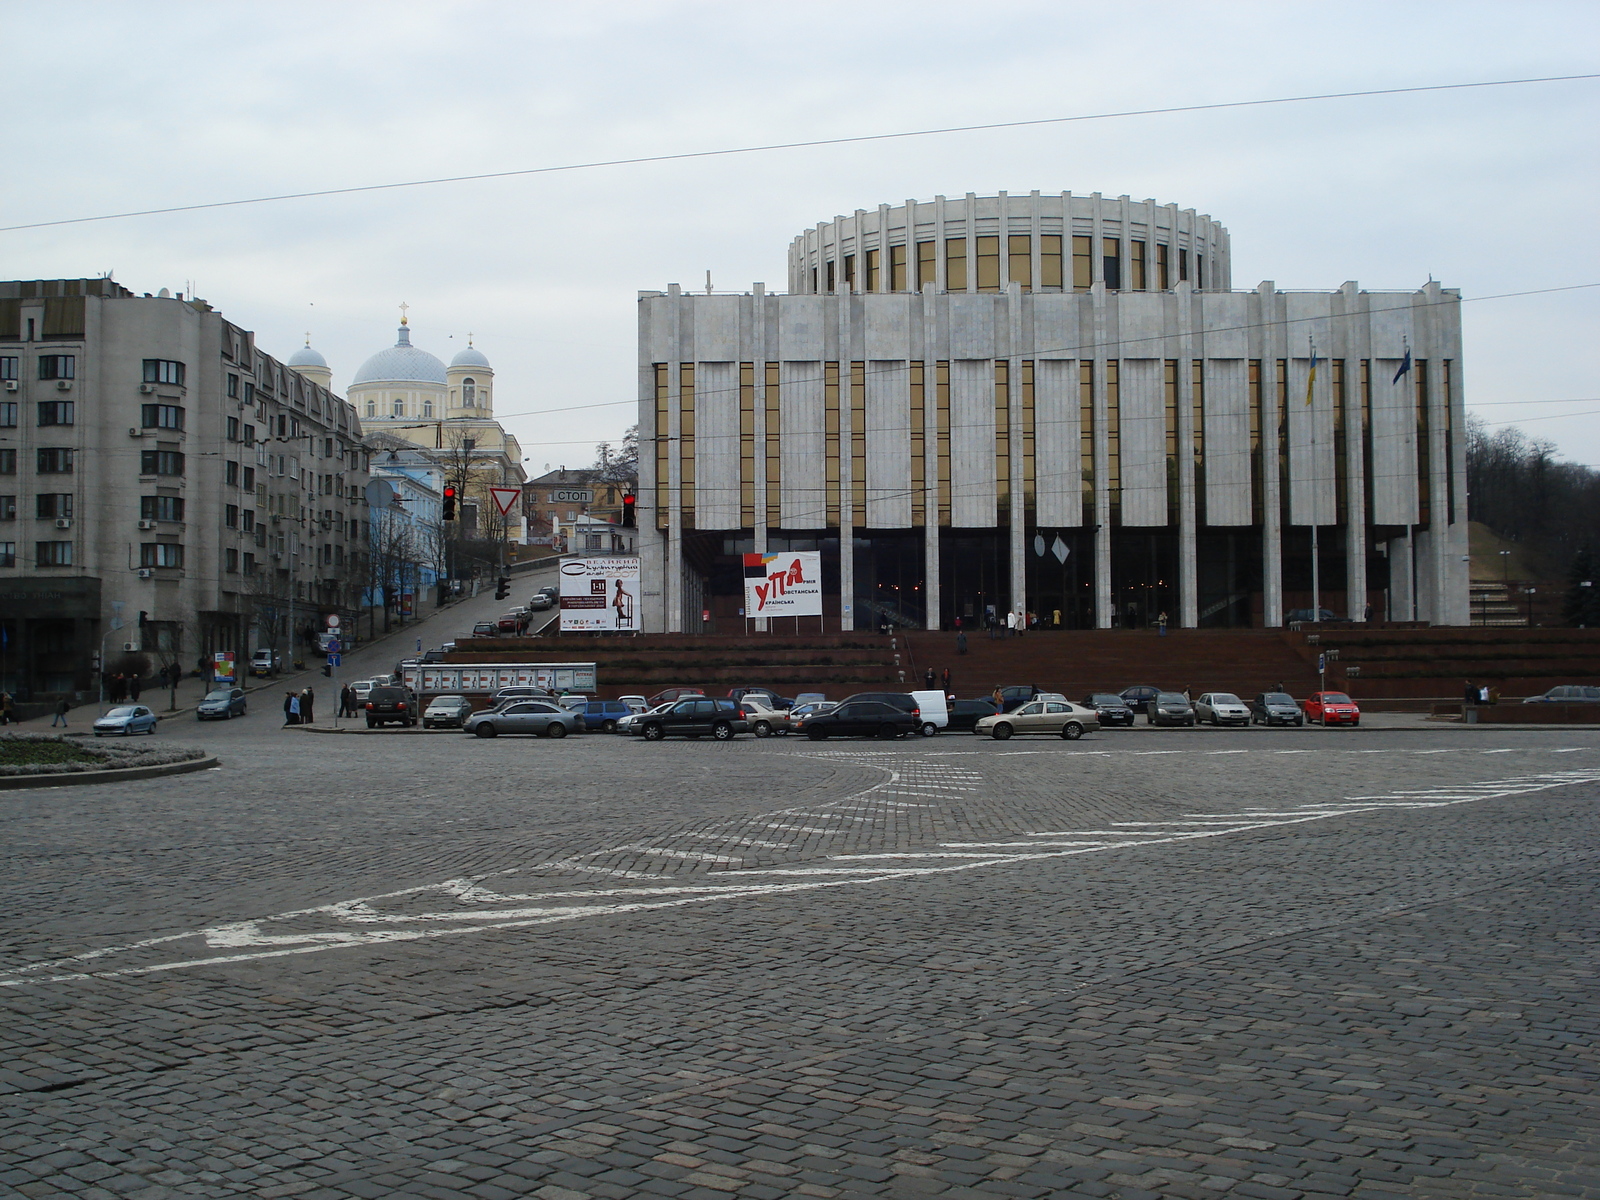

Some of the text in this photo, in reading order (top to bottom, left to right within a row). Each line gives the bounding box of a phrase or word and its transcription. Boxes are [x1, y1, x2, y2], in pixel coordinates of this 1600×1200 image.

[558, 491, 587, 500] СТОП
[605, 570, 638, 578] 2007
[592, 582, 605, 590] 1-11
